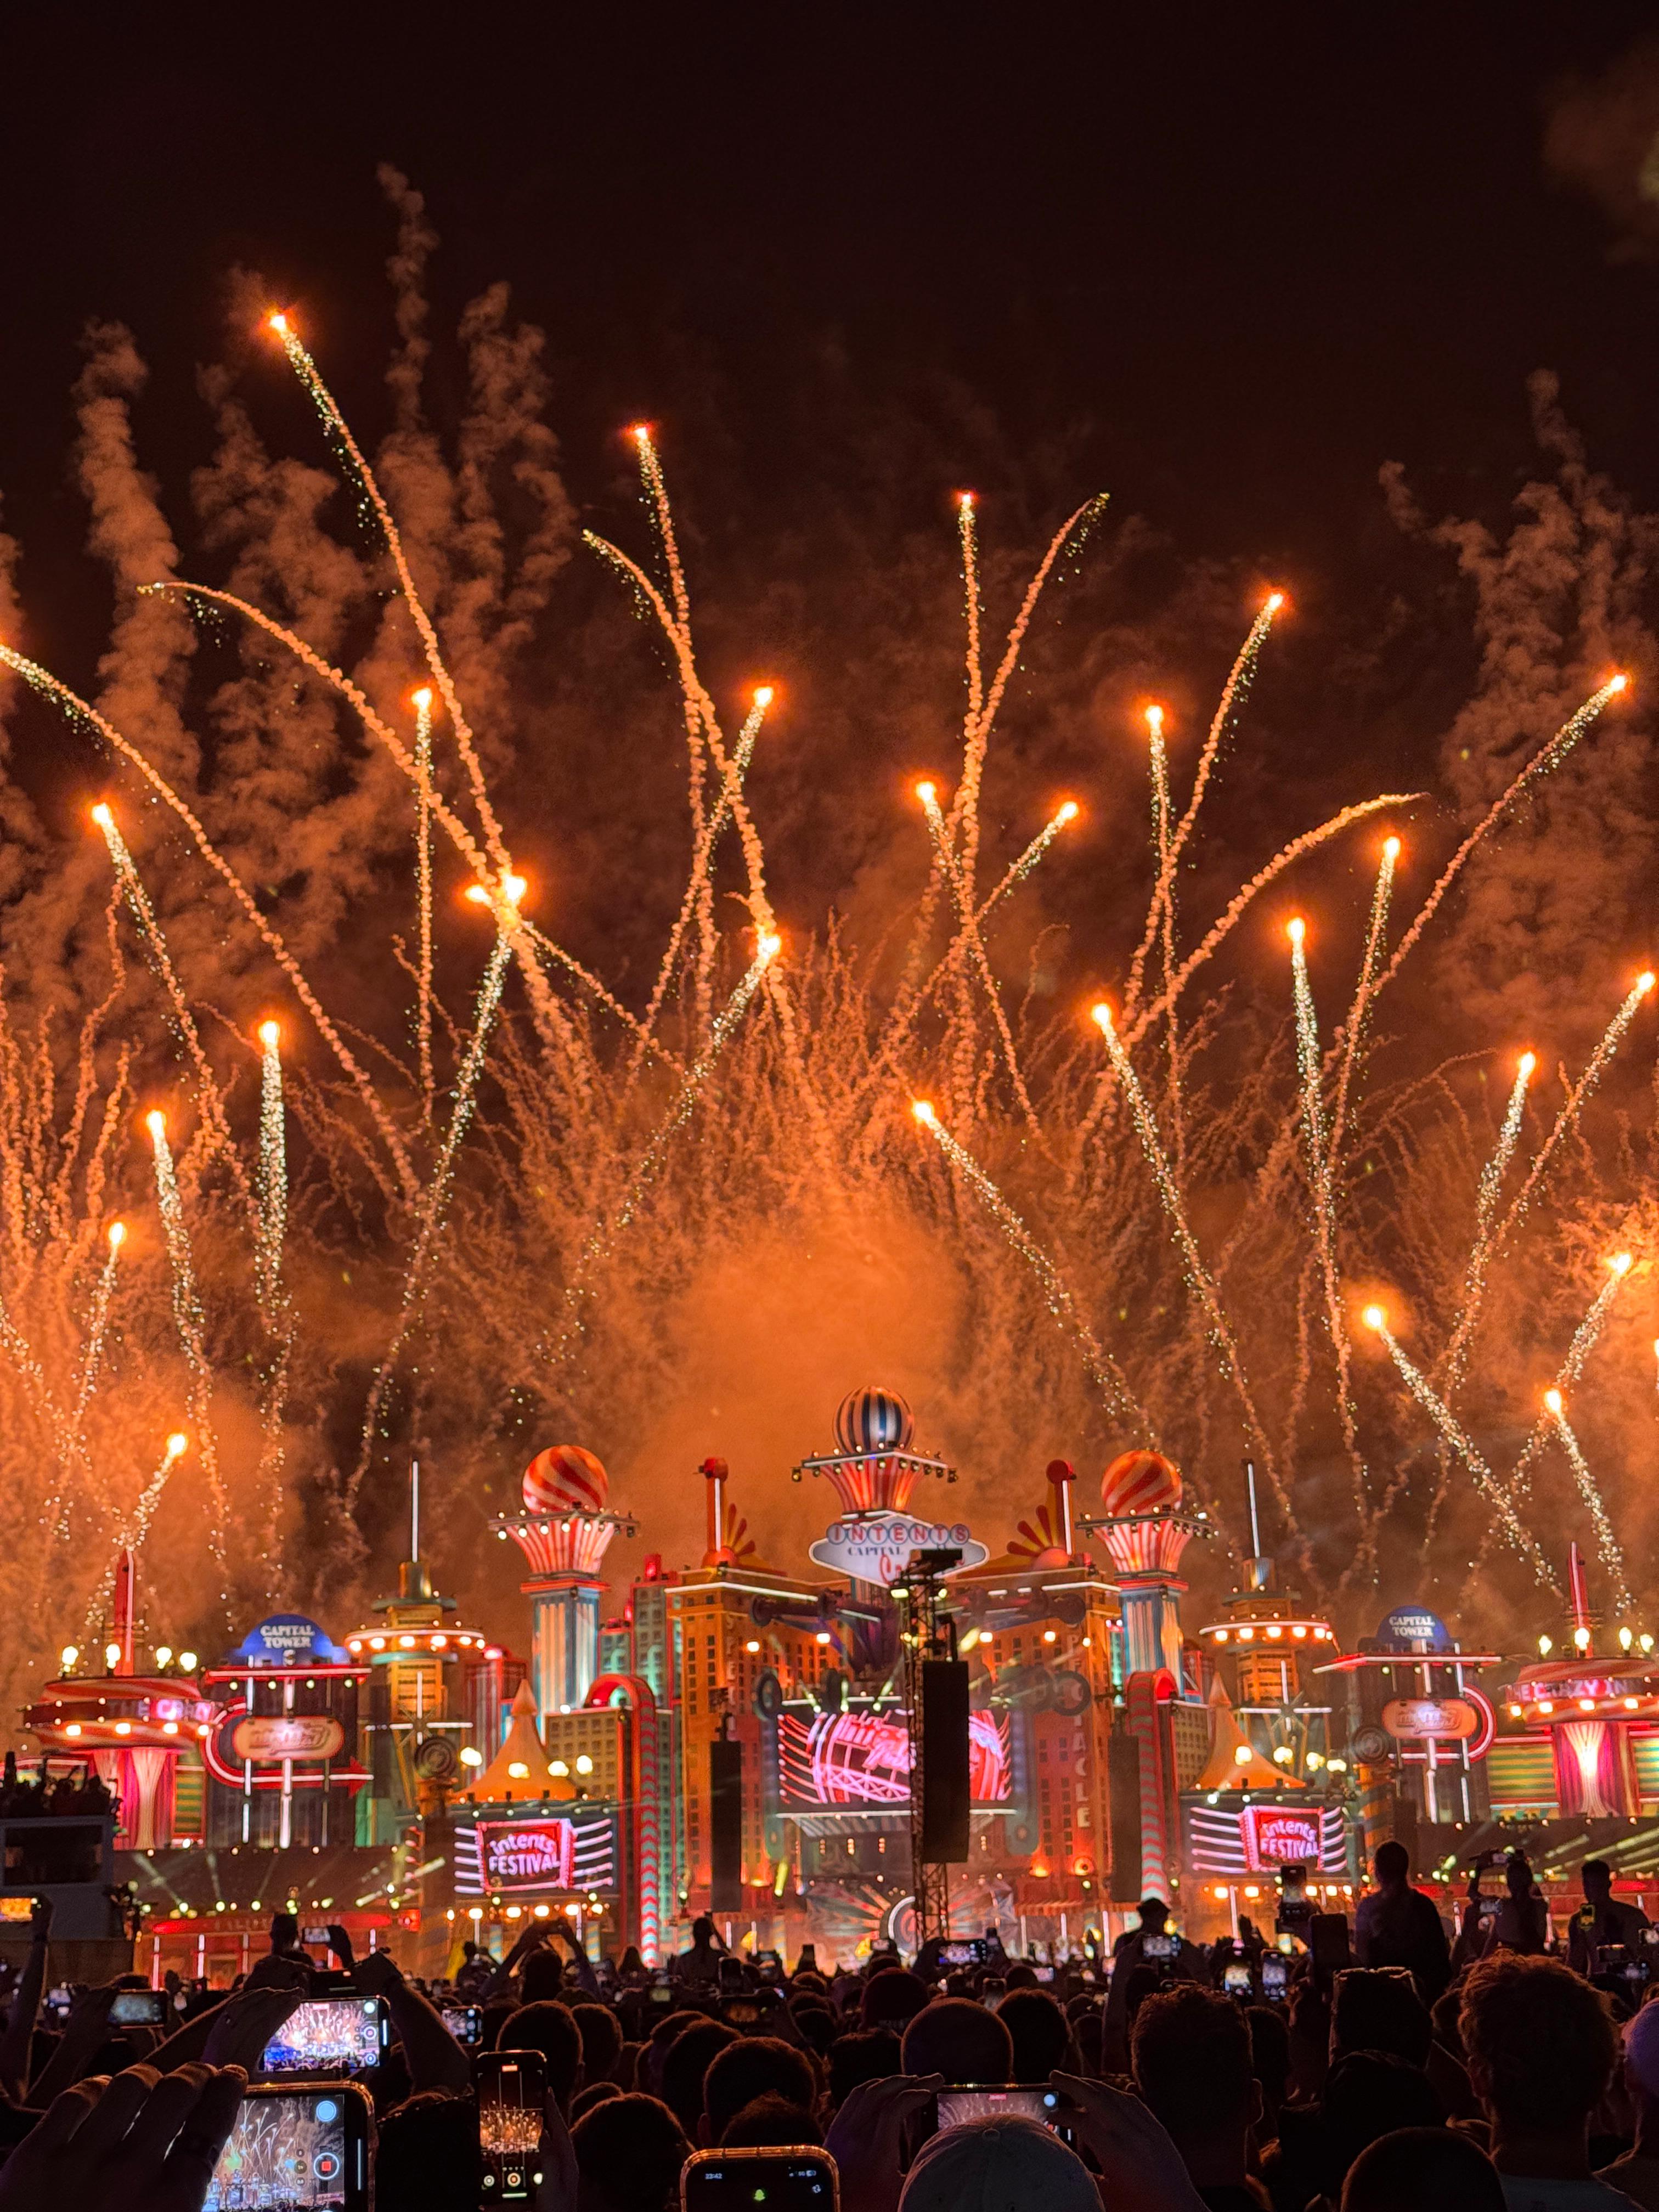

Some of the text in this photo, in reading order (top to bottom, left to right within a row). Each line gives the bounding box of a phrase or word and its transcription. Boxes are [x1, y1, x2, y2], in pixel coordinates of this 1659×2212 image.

[833, 1526, 967, 1542] INTENTS
[848, 1546, 904, 1556] CAPITAL
[1389, 1615, 1436, 1627] CAPITAL
[259, 1624, 315, 1637] CAPITAL
[1392, 1626, 1434, 1638] TOWER
[263, 1636, 312, 1649] TOWER
[1262, 1819, 1317, 1842] intents
[489, 1833, 556, 1856] intents
[1260, 1837, 1320, 1859] FESTIVAL
[488, 1853, 561, 1876] FESTIVAL
